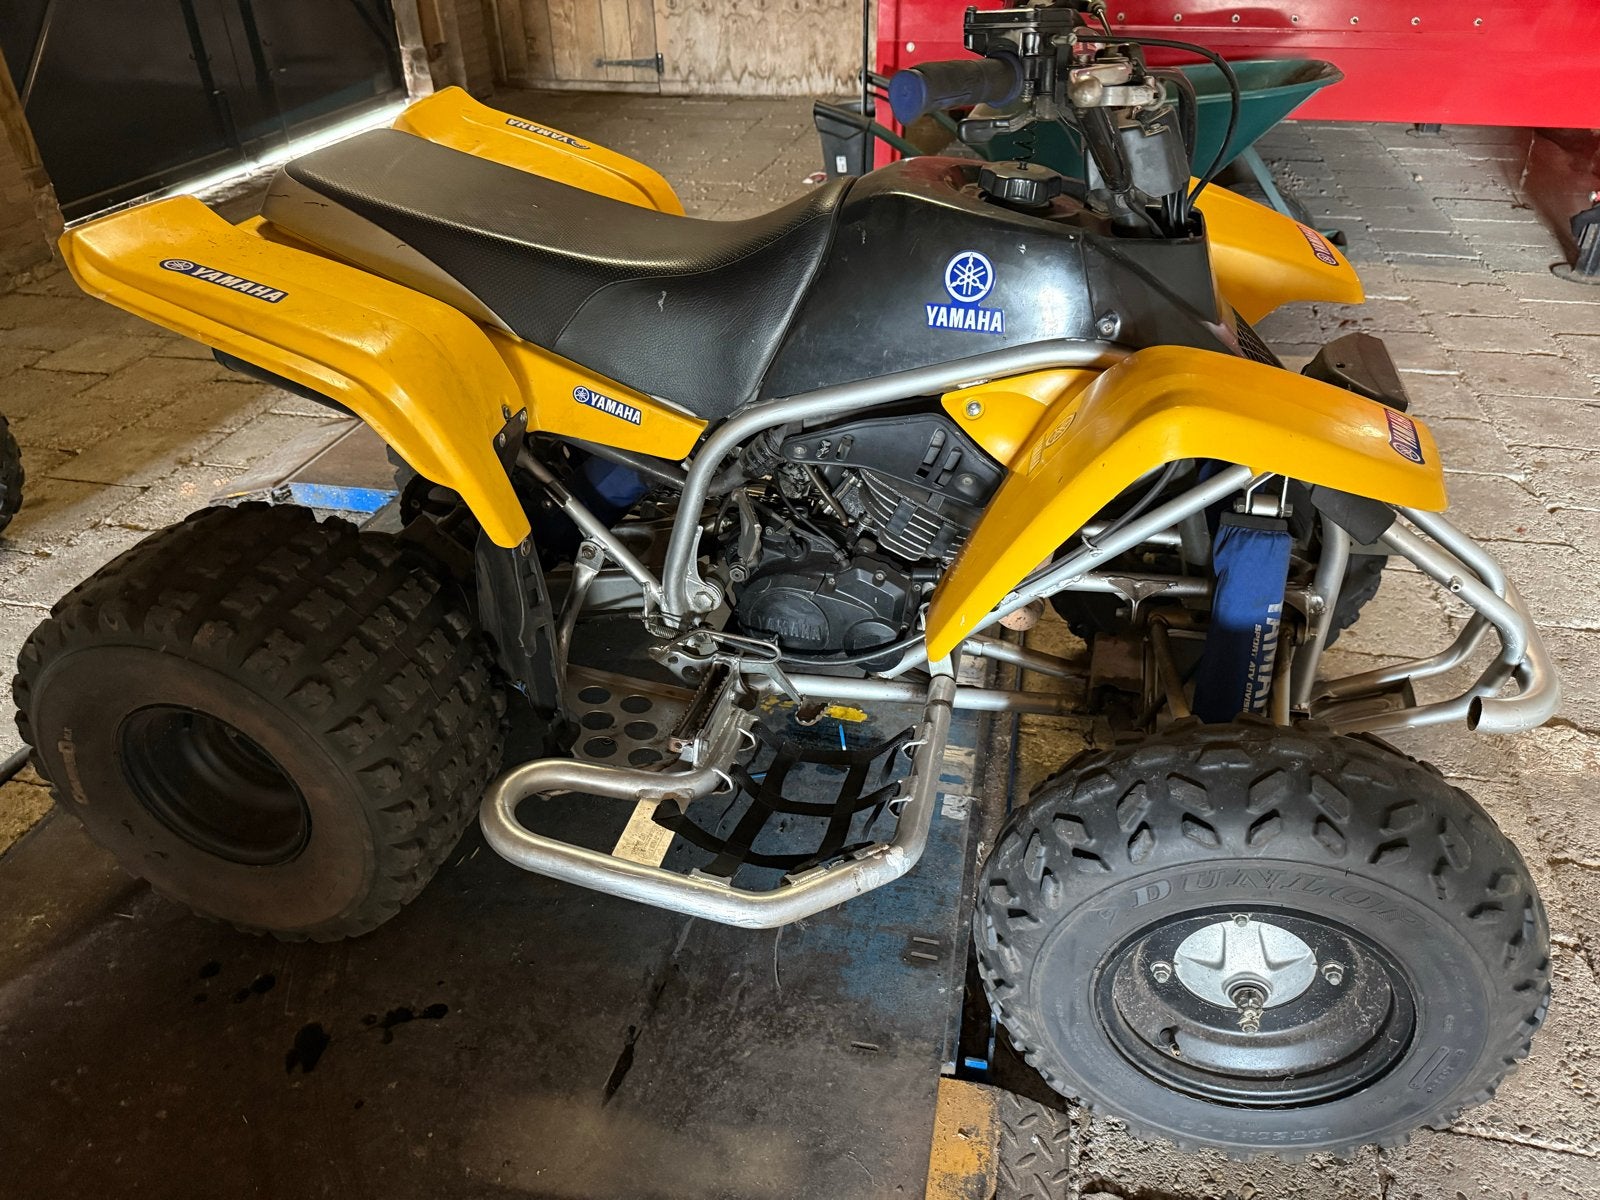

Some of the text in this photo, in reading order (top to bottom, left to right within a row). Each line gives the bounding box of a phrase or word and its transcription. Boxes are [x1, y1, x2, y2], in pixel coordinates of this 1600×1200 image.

[507, 118, 569, 143] YAMAHA
[191, 266, 285, 302] YAMAHA
[926, 305, 1003, 333] YAMAHA
[591, 392, 641, 424] YAMAHA
[1242, 624, 1262, 713] SPORT ATV DIVISI
[1253, 600, 1284, 717] YAMA
[1128, 867, 1432, 930] DUNLOP
